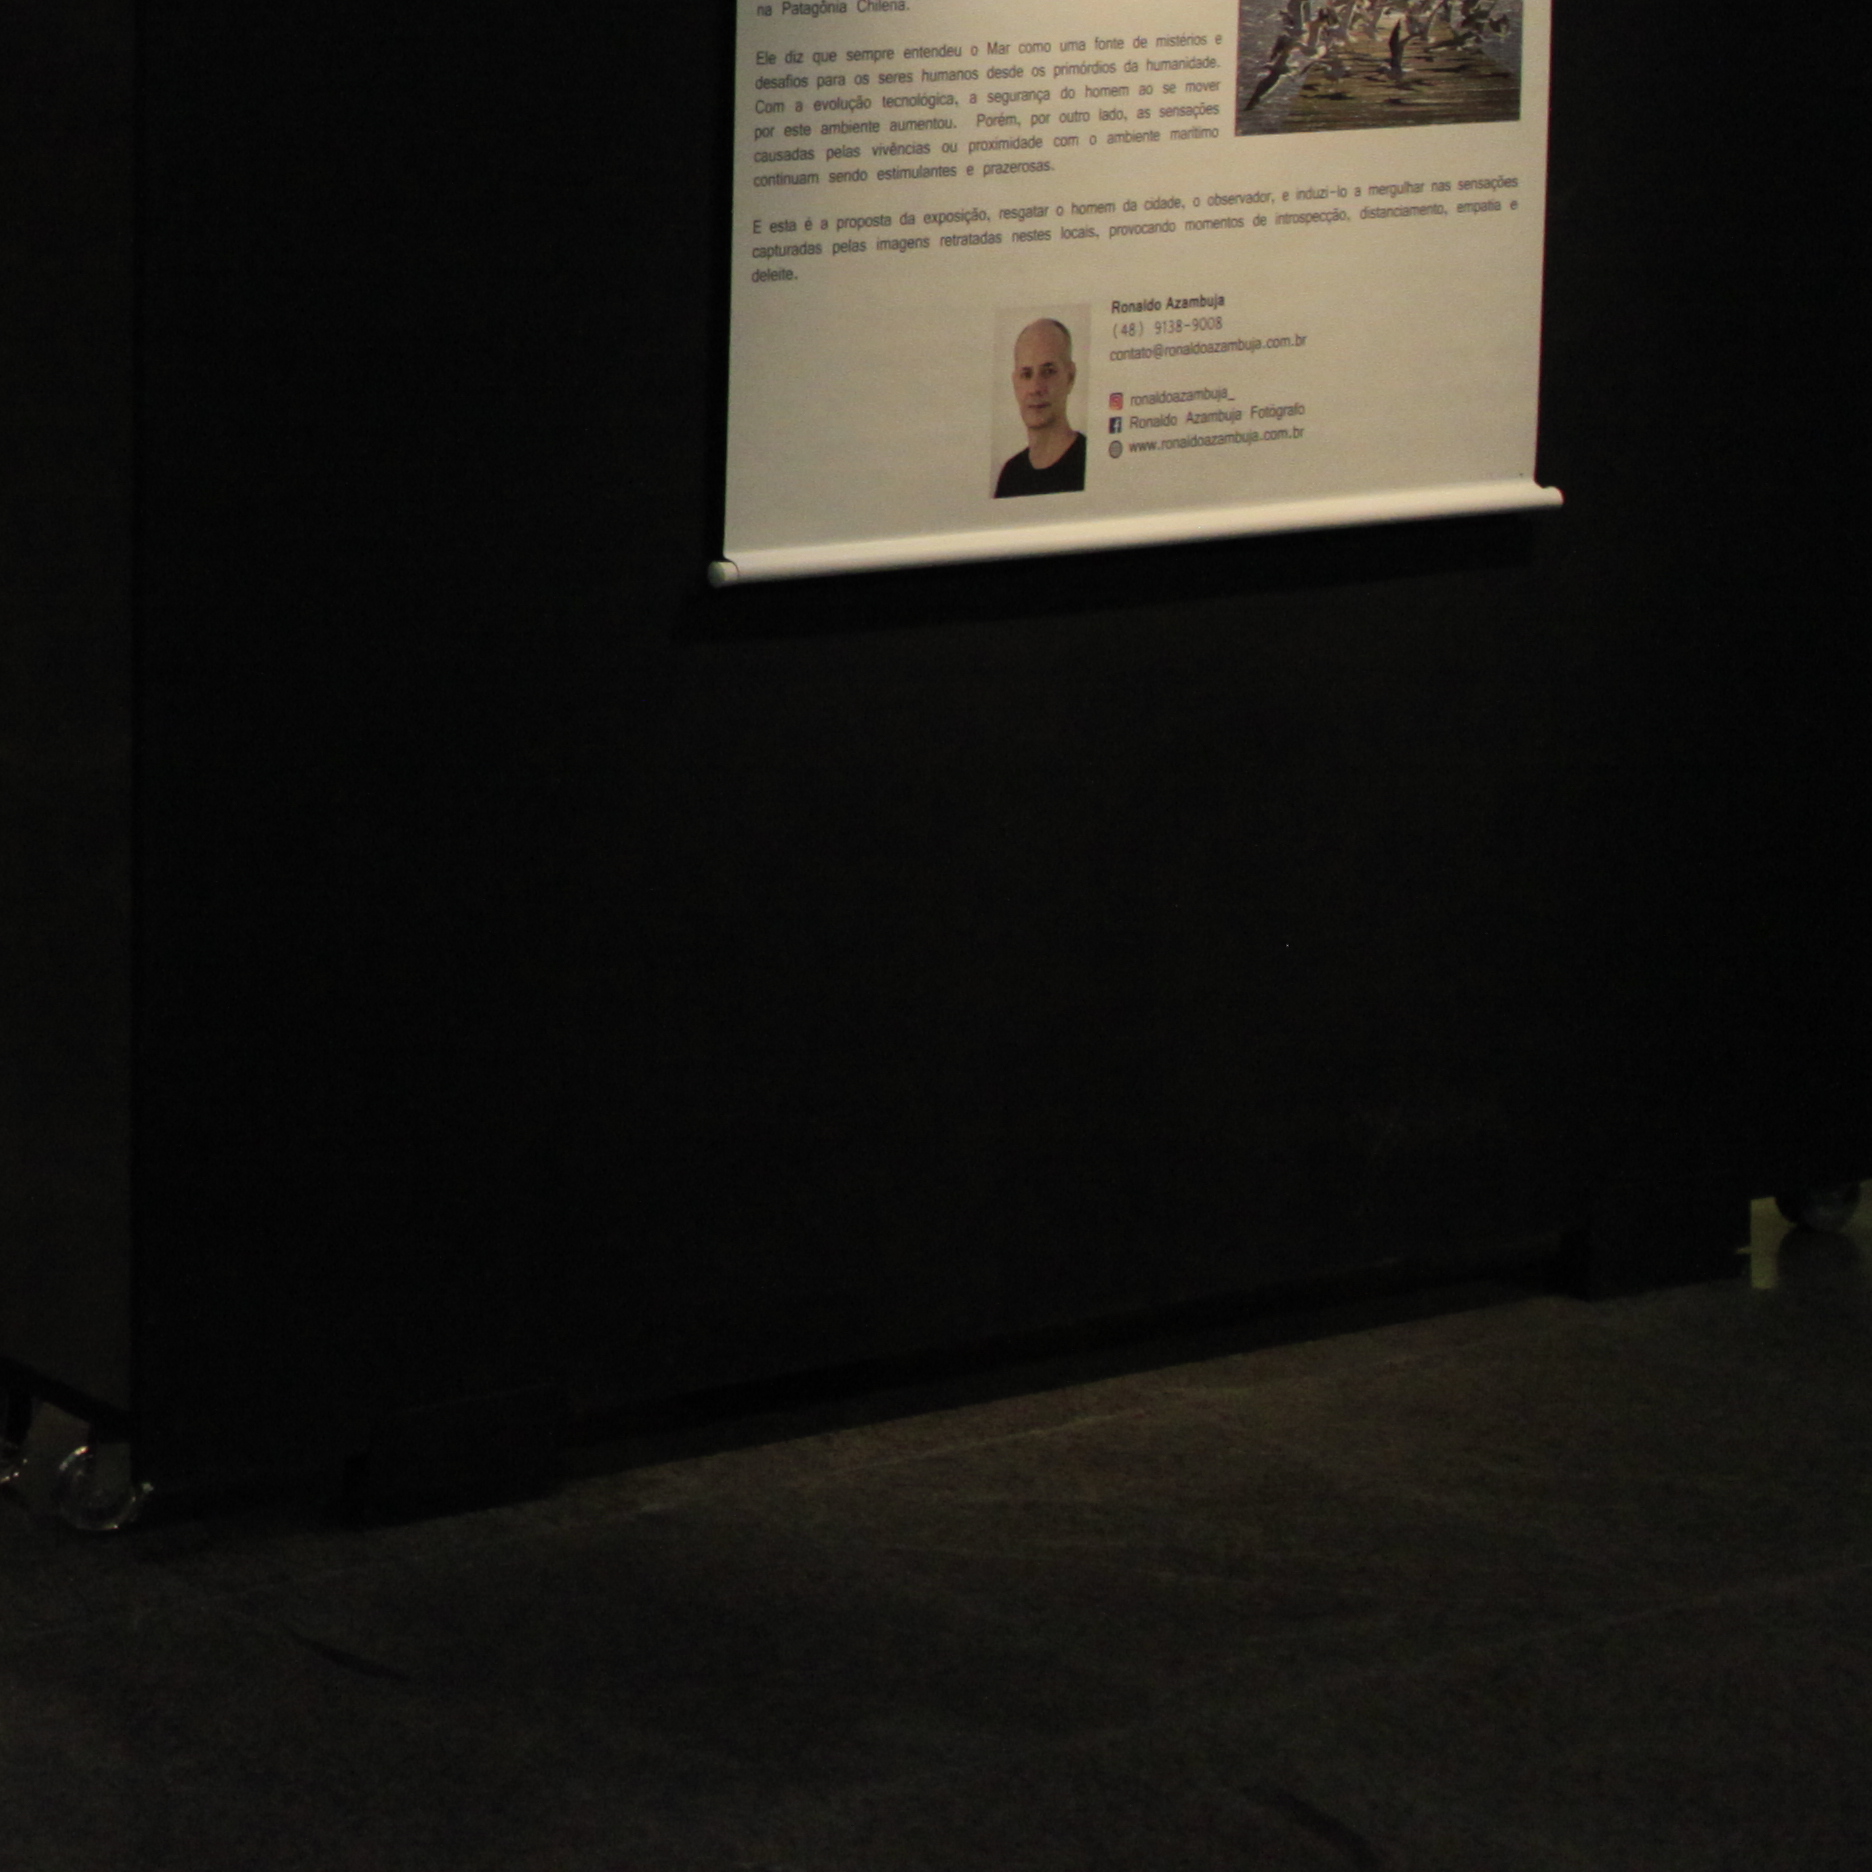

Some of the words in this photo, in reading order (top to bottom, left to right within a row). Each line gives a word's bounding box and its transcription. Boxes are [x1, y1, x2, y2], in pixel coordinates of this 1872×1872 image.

[846, 48, 894, 64] sempre
[903, 42, 962, 58] entendeu
[1094, 34, 1124, 50] fonte
[755, 72, 808, 89] desafios
[878, 72, 913, 84] seres
[922, 66, 979, 82] humanos
[986, 62, 1024, 79] desde
[813, 93, 872, 113] evolução
[987, 89, 1050, 106] segurança
[1085, 83, 1129, 98] homem
[1185, 80, 1221, 92] mover
[821, 117, 880, 134] ambiente
[890, 114, 956, 131] aumentou.
[1059, 107, 1090, 123] outro
[753, 145, 815, 162] causadas
[826, 143, 860, 162] pelas
[968, 133, 1043, 155] proximidade
[1107, 126, 1160, 144] ambiente
[753, 170, 819, 186] continuam
[829, 166, 868, 182] sendo
[877, 161, 957, 180] estimulantes
[983, 160, 1054, 178] prazerosas.
[836, 211, 892, 233] proposta
[999, 202, 1049, 222] resgatar
[1071, 199, 1116, 214] homem
[1296, 183, 1347, 200] induzi-lo
[1368, 178, 1424, 199] mergulhar
[752, 239, 822, 261] capturadas
[832, 237, 866, 257] pelas
[876, 235, 930, 253] imagens
[940, 228, 1002, 246] retratadas
[1012, 225, 1051, 242] nestes
[1109, 217, 1176, 240] provocando
[1185, 213, 1244, 231] momentos
[1456, 196, 1501, 216] empatia
[1112, 296, 1161, 313] Ronaldo
[1166, 292, 1225, 311] Azambuja
[1129, 410, 1177, 428] Ronaldo
[1186, 405, 1242, 425] Azambuja
